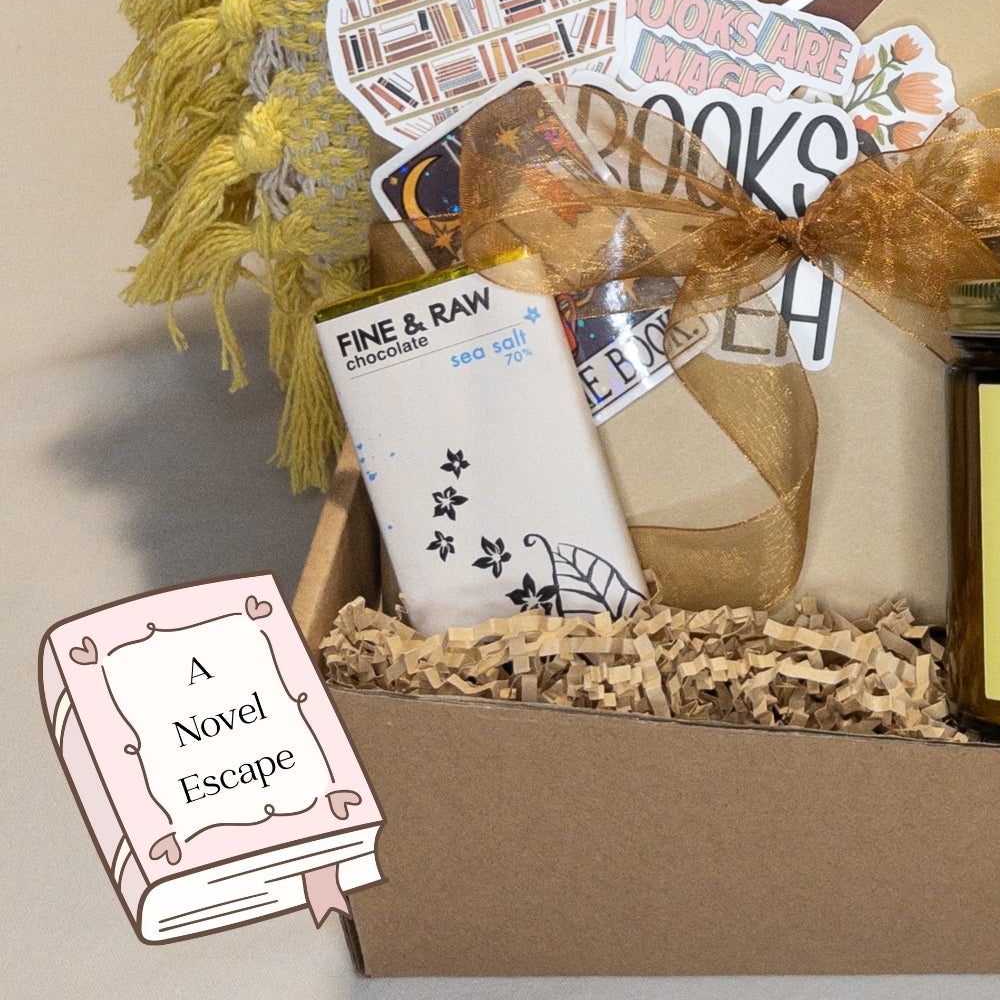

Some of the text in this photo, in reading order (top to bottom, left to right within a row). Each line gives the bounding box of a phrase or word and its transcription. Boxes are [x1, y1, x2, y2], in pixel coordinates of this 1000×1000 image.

[758, 12, 854, 85] ARE
[336, 286, 491, 358] FINE & RAW
[345, 334, 429, 372] chocolate
[450, 327, 527, 368] sea salt
[505, 346, 533, 367] 70%
